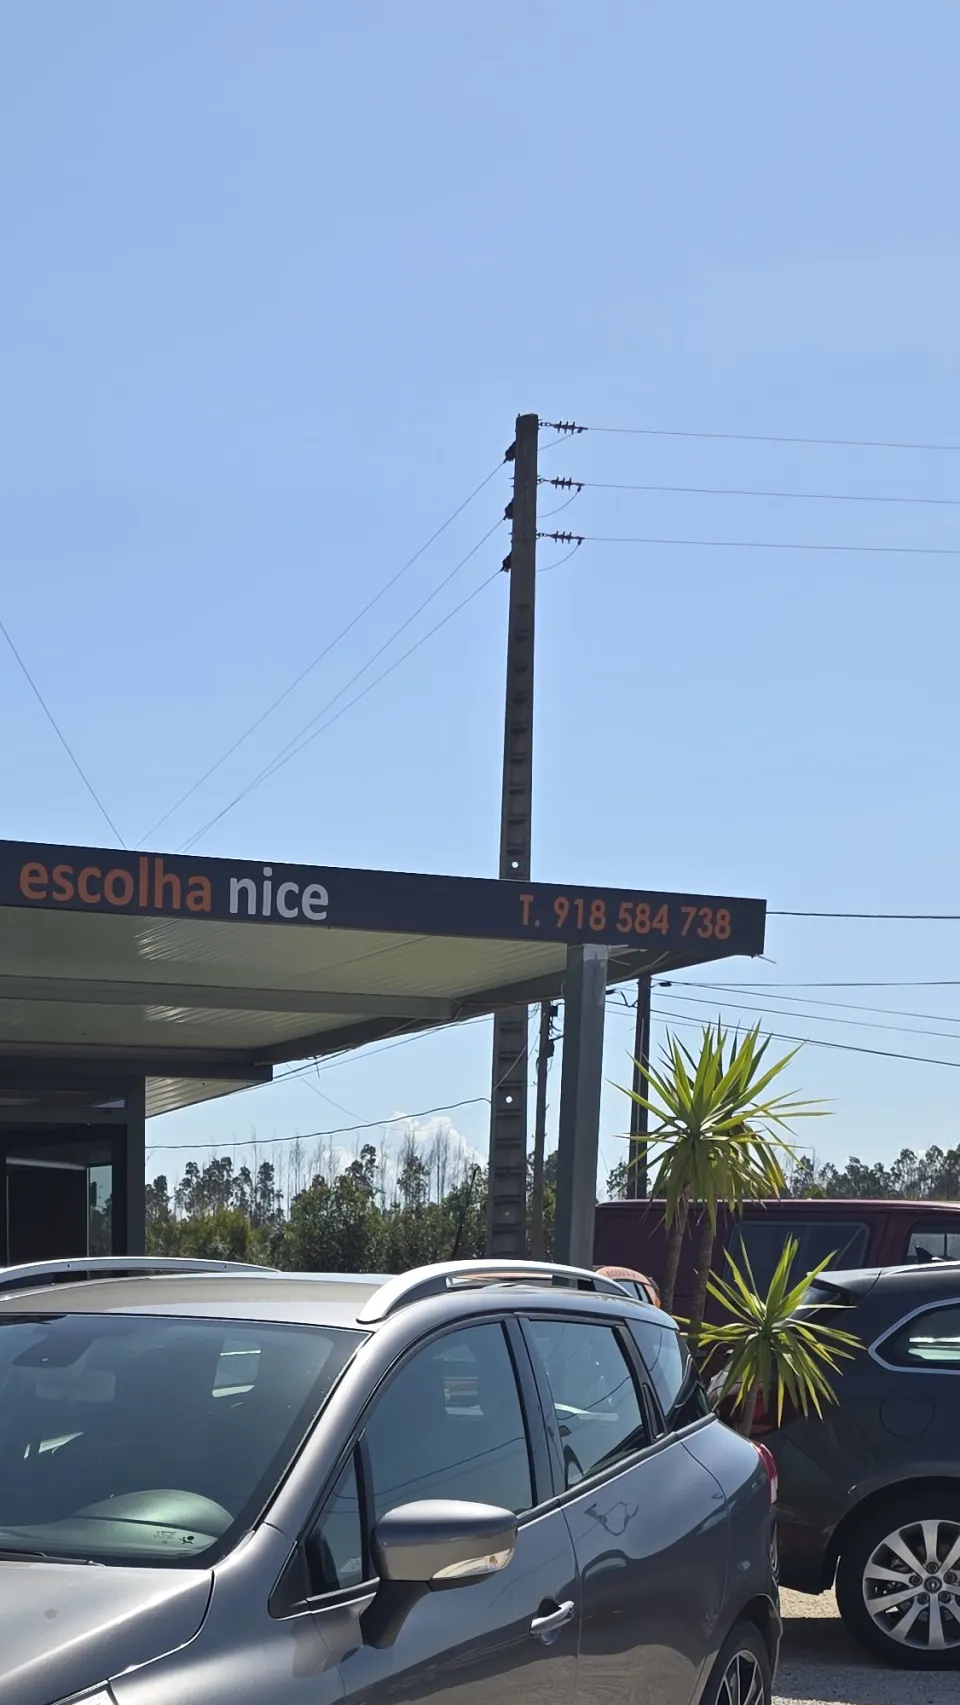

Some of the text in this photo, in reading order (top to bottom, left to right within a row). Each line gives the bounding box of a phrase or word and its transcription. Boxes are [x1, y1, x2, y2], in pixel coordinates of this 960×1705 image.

[20, 857, 212, 912] escolha
[229, 867, 329, 920] nice
[520, 895, 732, 940] T. 918 584 738
